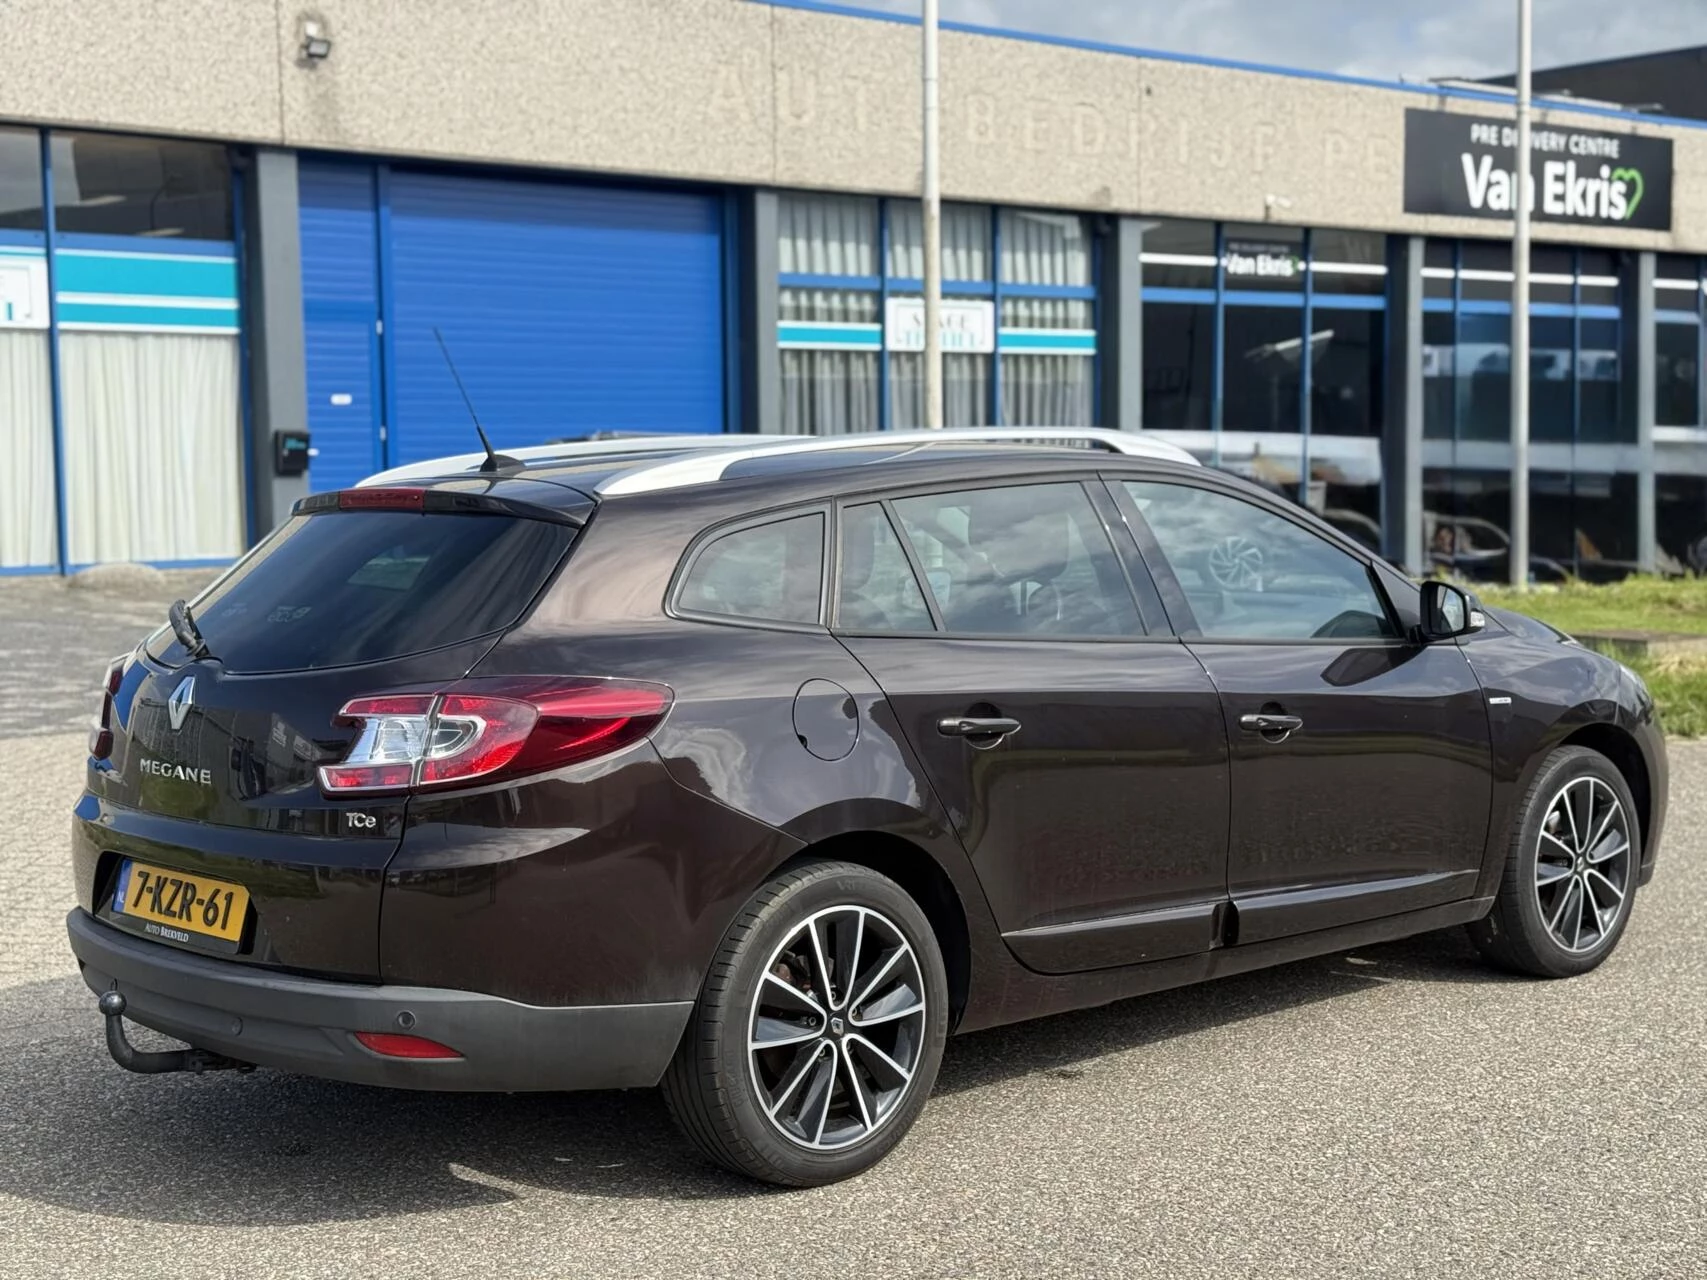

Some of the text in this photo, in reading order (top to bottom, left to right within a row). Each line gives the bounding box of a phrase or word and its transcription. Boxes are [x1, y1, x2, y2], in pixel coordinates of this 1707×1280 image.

[1470, 123, 1499, 146] PRE
[1570, 135, 1619, 159] CENTRE
[1543, 159, 1628, 220] Ekris
[1227, 253, 1254, 274] Van
[140, 758, 212, 786] MEGANE
[345, 812, 377, 829] TCe
[132, 871, 235, 930] 7-KZR-61
[144, 922, 189, 943] AUTO BREKVELD
